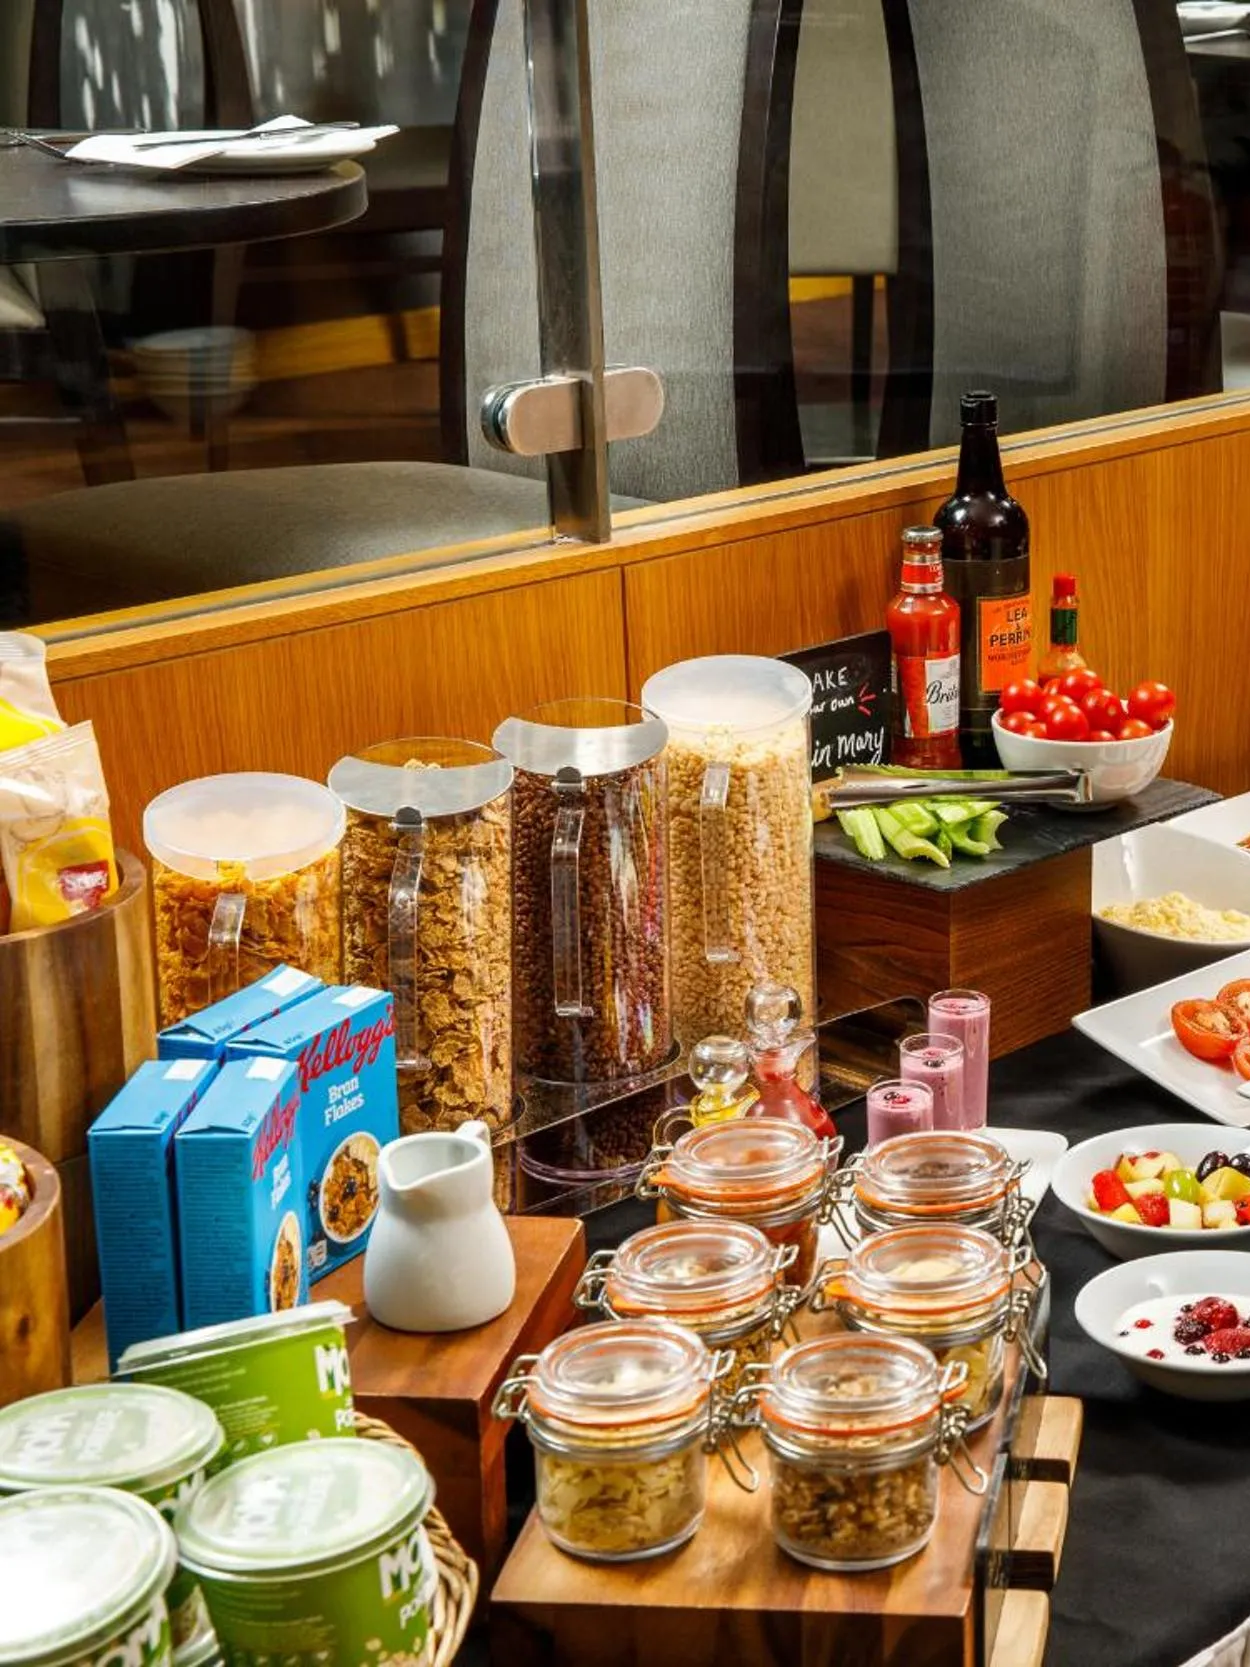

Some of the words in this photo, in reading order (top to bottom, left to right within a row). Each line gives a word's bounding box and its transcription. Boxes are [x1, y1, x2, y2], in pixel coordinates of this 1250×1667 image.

[1007, 607, 1028, 623] LEA
[812, 666, 848, 693] AKE
[830, 695, 854, 711] own
[837, 726, 885, 767] Mary
[297, 1003, 395, 1094] Kellogg's
[328, 1076, 360, 1104] Bran
[324, 1093, 364, 1127] Flakes
